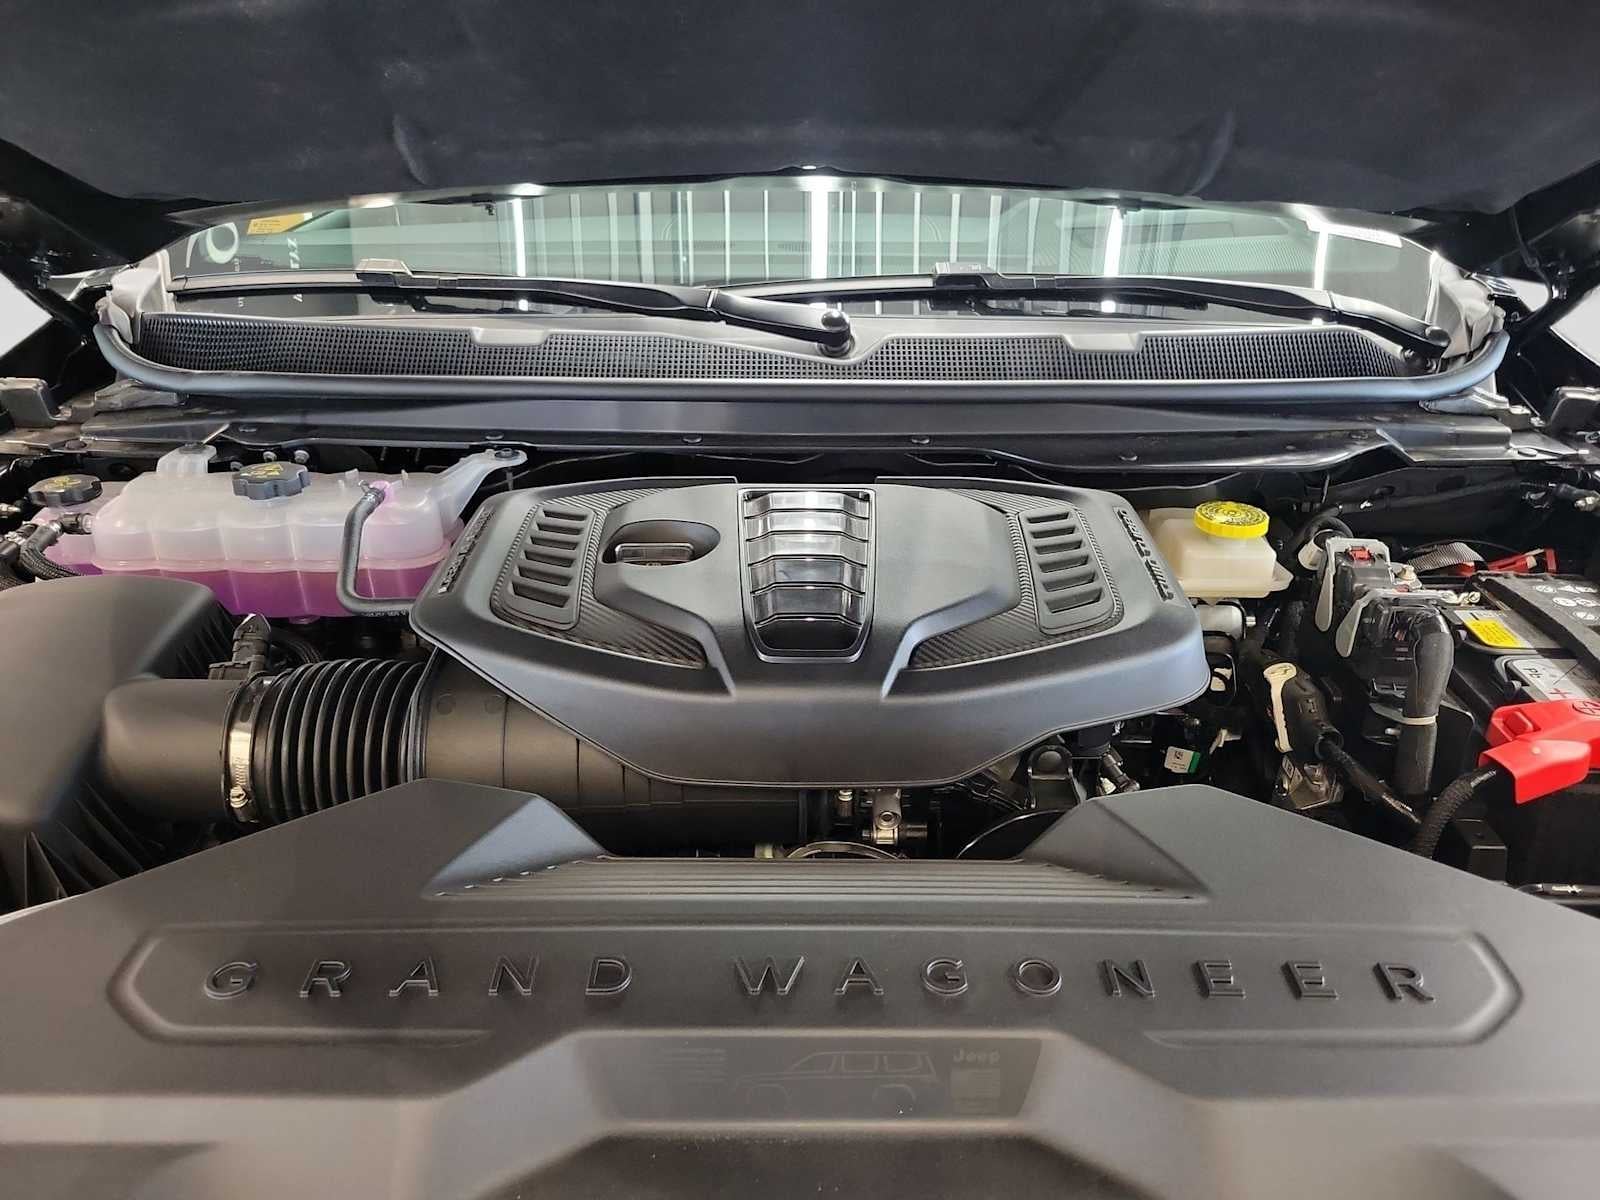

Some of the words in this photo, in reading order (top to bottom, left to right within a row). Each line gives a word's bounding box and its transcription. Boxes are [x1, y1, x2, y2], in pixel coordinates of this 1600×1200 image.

[202, 954, 634, 999] GRAND
[733, 955, 1435, 1002] WAGONEER
[952, 1048, 1001, 1065] Jeep
